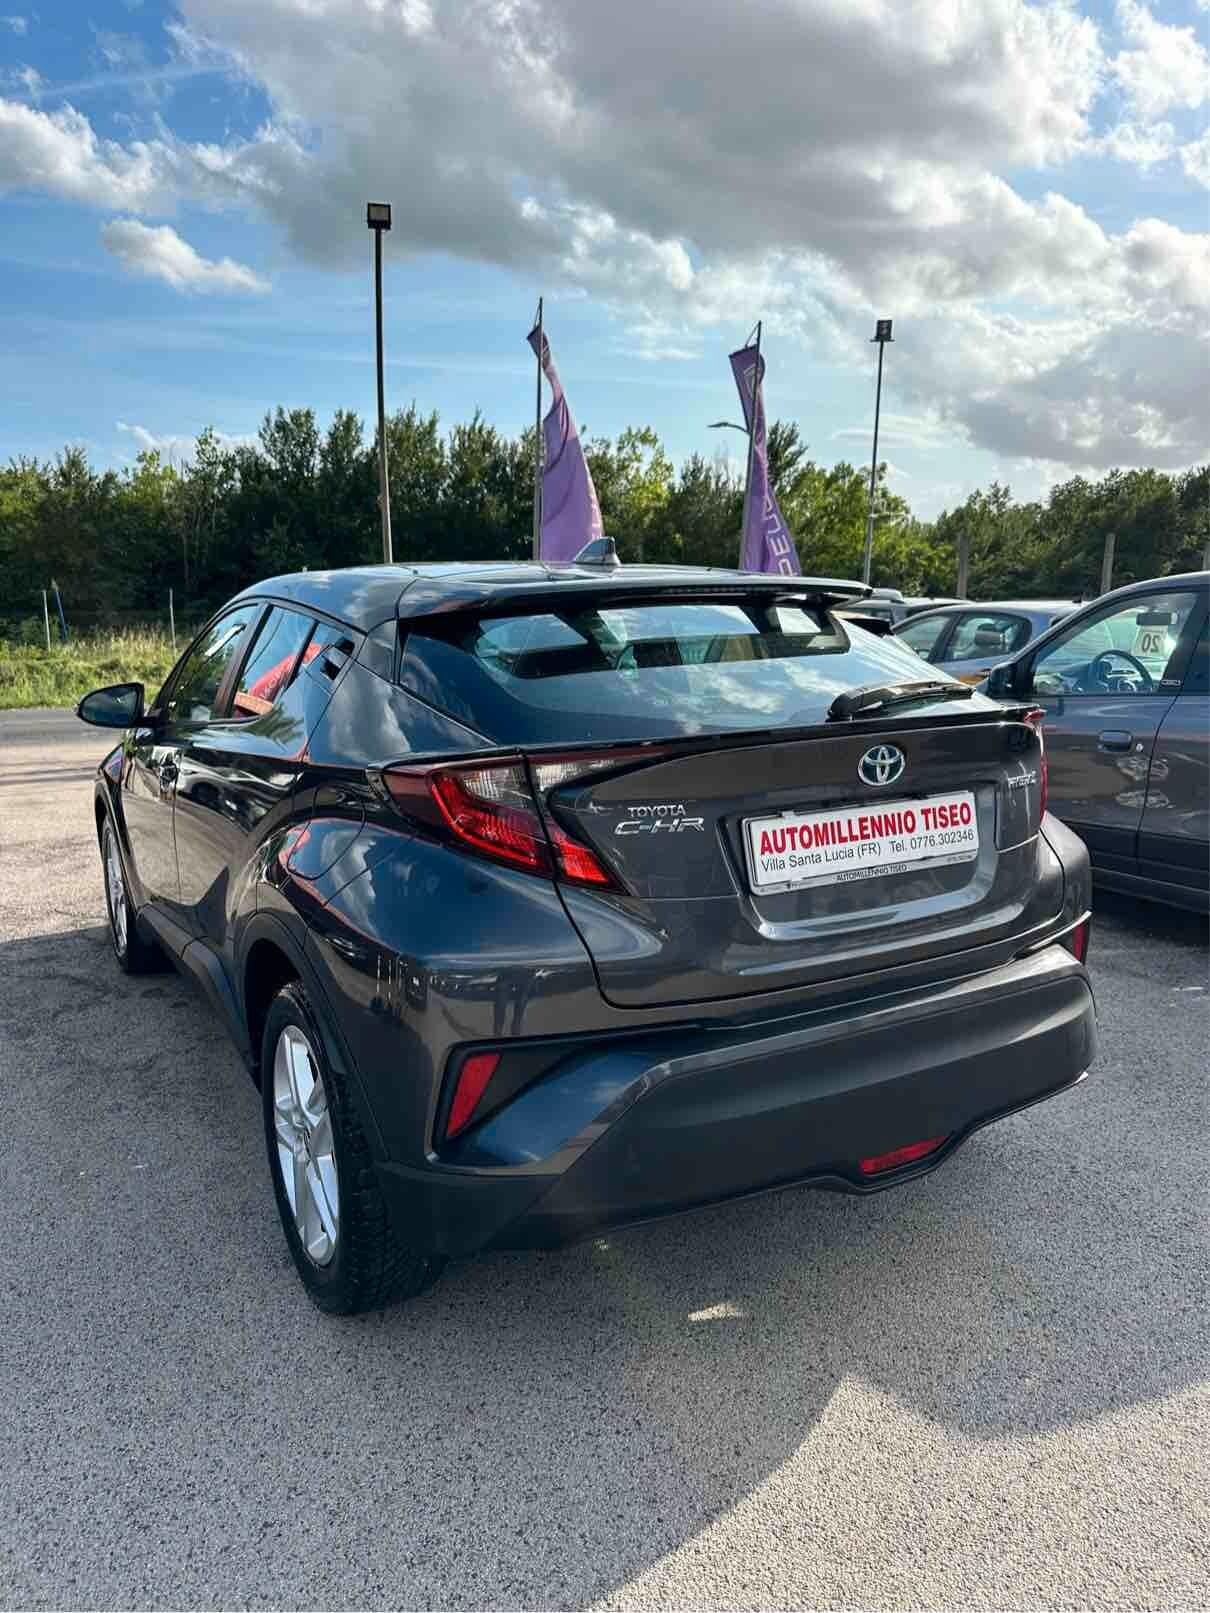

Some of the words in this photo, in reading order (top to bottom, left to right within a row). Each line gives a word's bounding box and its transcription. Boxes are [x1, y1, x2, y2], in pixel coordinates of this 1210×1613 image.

[614, 817, 704, 835] C-HR
[627, 804, 686, 817] TOYOTA
[760, 810, 916, 855] AUTOMILLENNIO
[921, 802, 971, 831] TISEO
[761, 856, 785, 872] Villa
[788, 852, 822, 868] Santa
[824, 846, 854, 862] Lucia
[857, 841, 881, 859] (FR)
[889, 838, 907, 853] Tel.
[910, 828, 974, 849] 0776.302346
